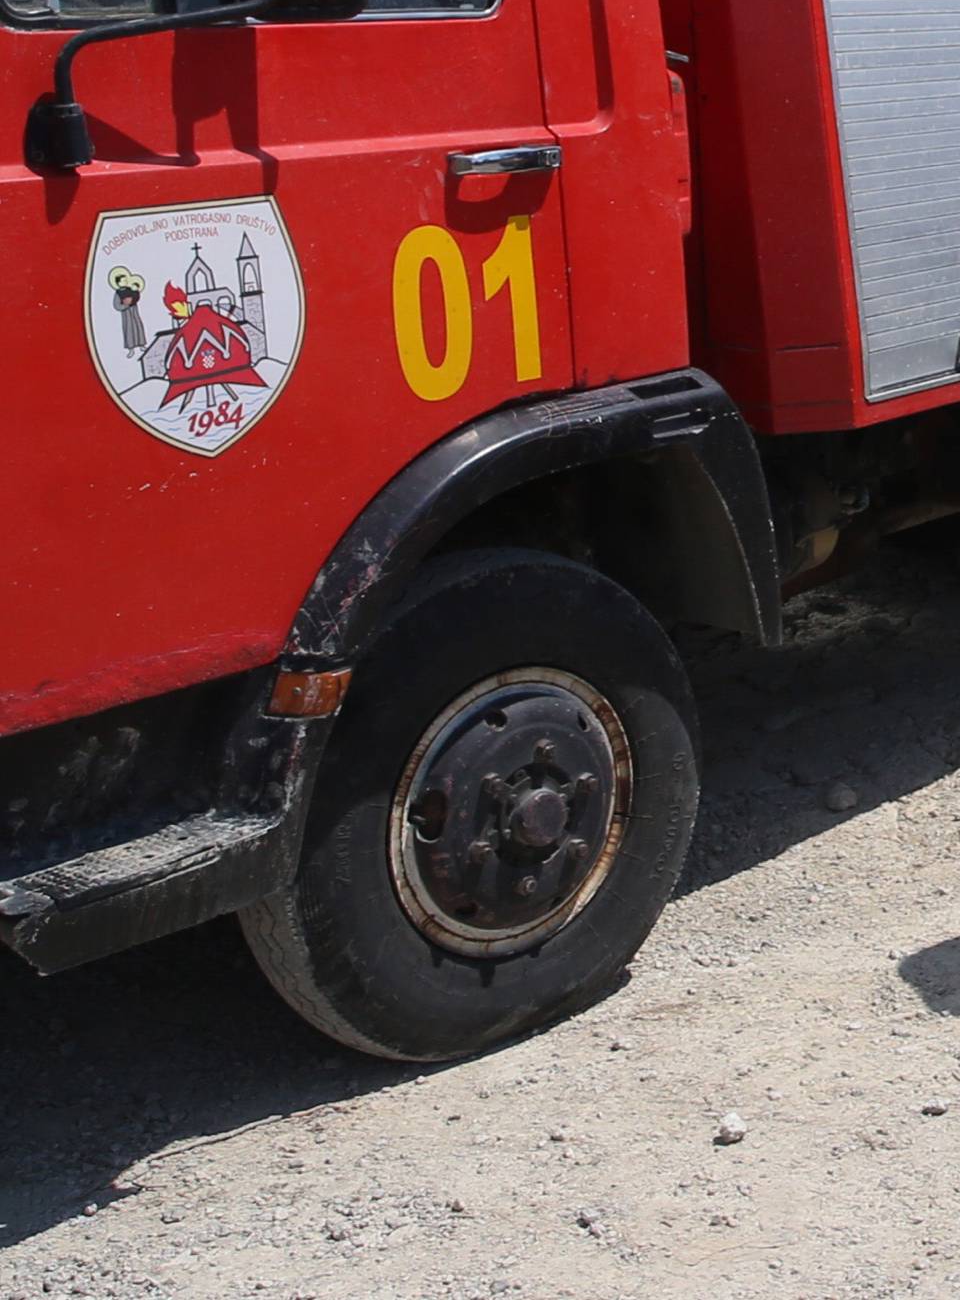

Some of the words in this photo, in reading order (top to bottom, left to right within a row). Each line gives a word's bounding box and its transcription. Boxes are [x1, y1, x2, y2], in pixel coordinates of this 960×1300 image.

[103, 219, 168, 255] DOBROVOLJNO
[172, 213, 232, 227] VATROGASNO
[236, 214, 277, 236] DRUŠTVO
[165, 227, 219, 242] PODSTRANA
[393, 215, 542, 401] 01
[188, 401, 245, 437] 1984
